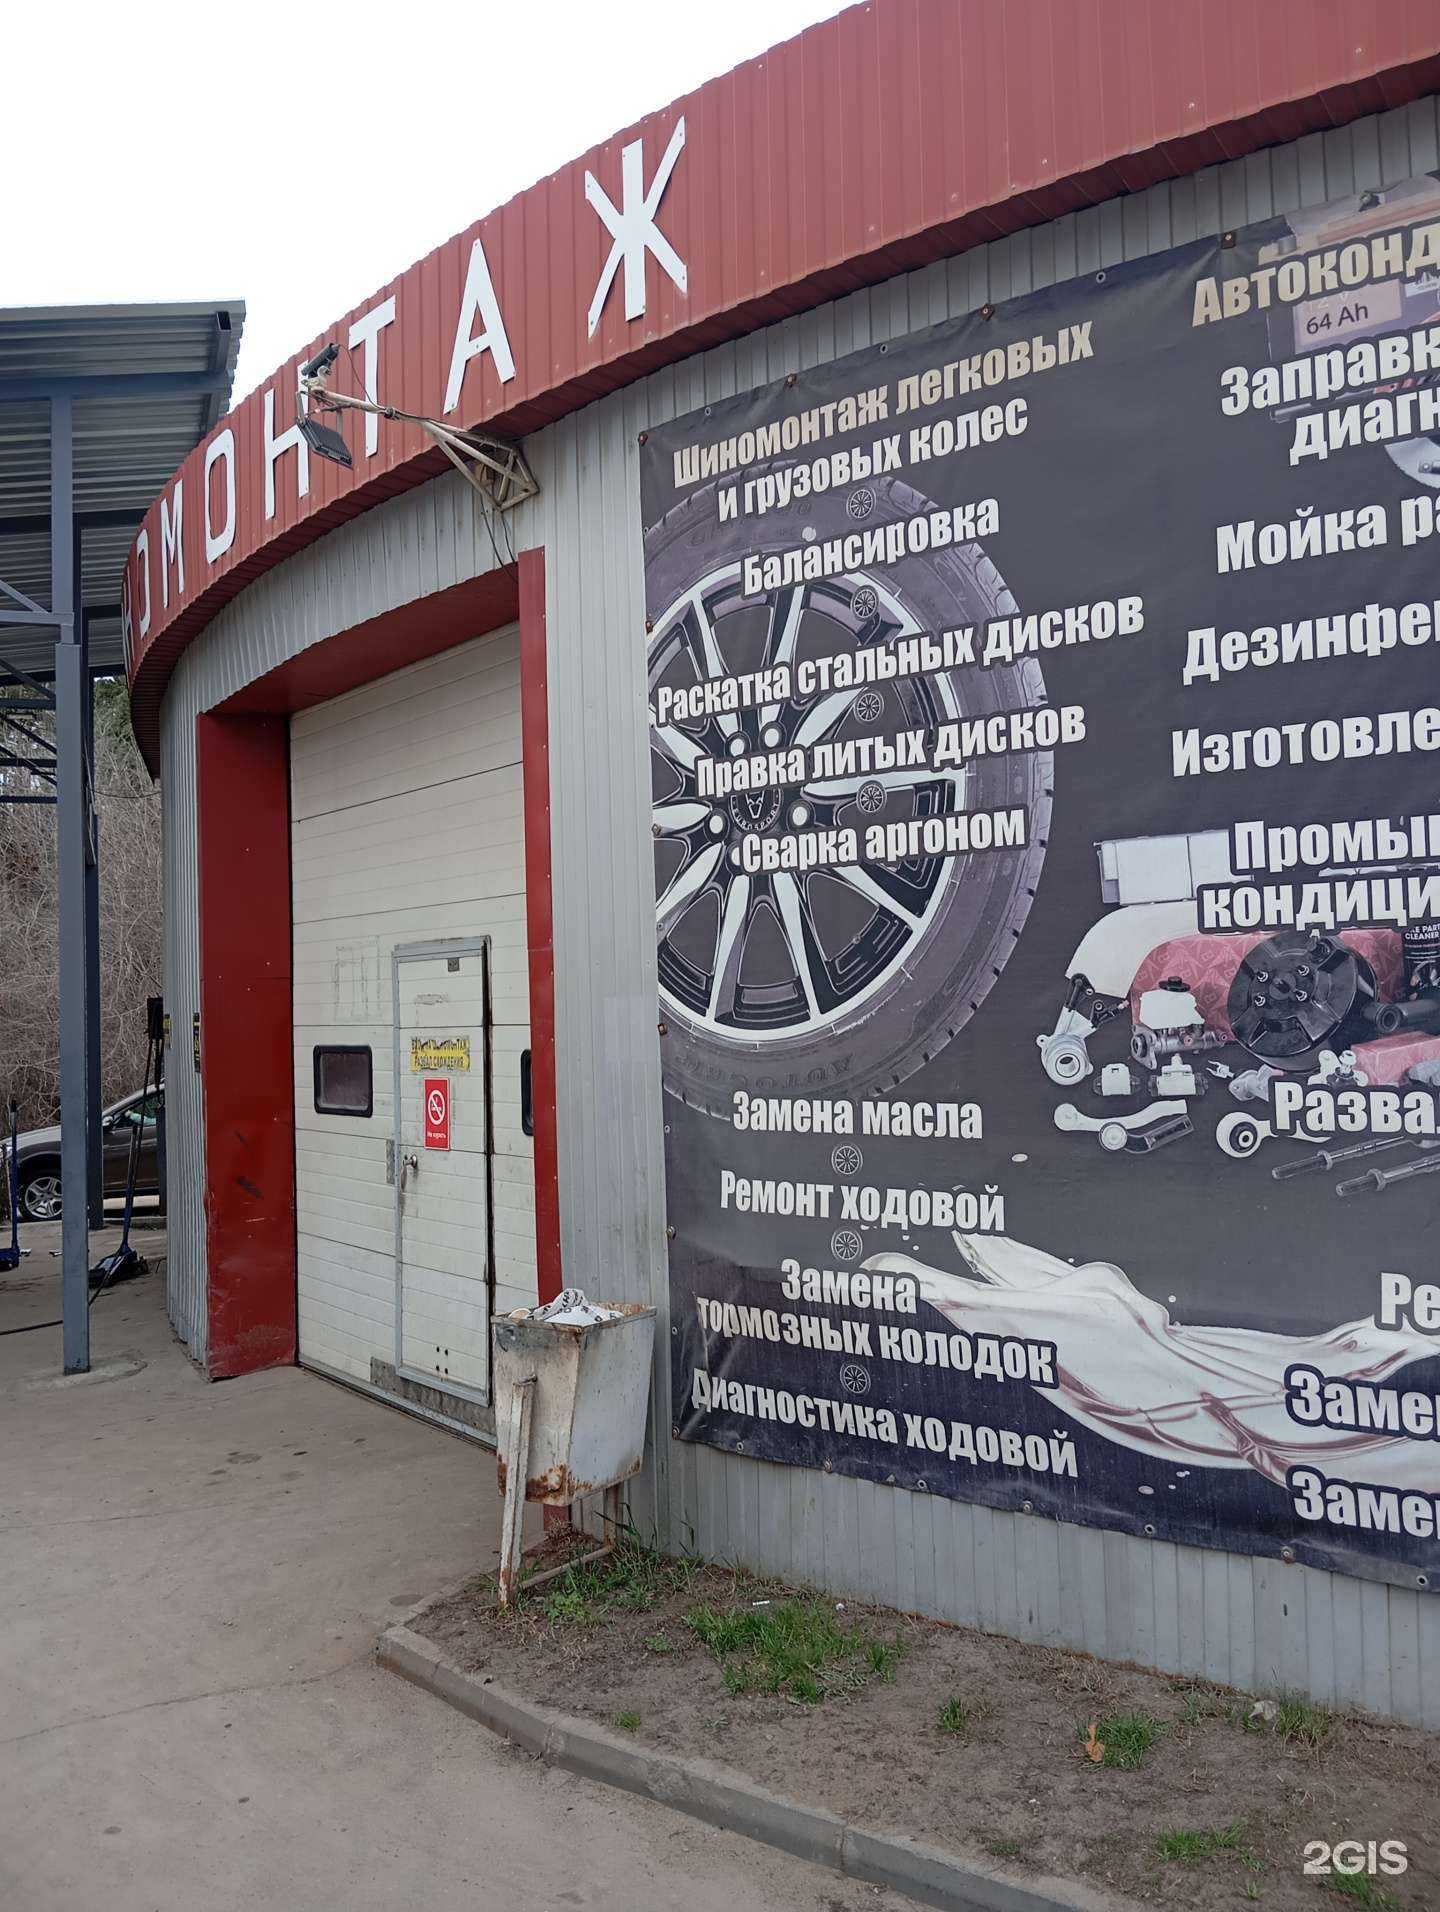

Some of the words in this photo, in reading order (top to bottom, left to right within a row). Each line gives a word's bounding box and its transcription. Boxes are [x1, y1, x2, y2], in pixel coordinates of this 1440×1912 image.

[1192, 223, 1440, 328] Автоконд
[1306, 313, 1332, 334] 64
[1338, 303, 1369, 327] Ah
[121, 116, 688, 676] НОМОНТАЖ
[673, 384, 888, 488] Шиномонтаж
[896, 321, 1095, 415] легковых
[1220, 326, 1440, 416] Заправк
[717, 485, 738, 522] и
[744, 434, 902, 515] грузовых
[909, 398, 1029, 464] колес
[742, 498, 1000, 596] Балансировка
[1216, 505, 1388, 574] Мойка
[1401, 494, 1440, 547] р
[657, 665, 791, 725] Раскатка
[797, 626, 974, 694] стальных
[983, 596, 1145, 666] дисков
[1183, 600, 1440, 686] Дезинфе
[696, 747, 805, 799] Правка
[811, 727, 927, 780] литых
[934, 705, 1087, 768] дисков
[1172, 707, 1440, 777] Изготовле
[742, 827, 858, 873] Сварка
[866, 809, 1025, 865] аргоном
[1202, 875, 1440, 931] кондици
[1404, 931, 1440, 940] CLEANER
[733, 1090, 853, 1135] Замена
[862, 1100, 983, 1139] масла
[1274, 1081, 1440, 1134] Разва
[720, 1170, 834, 1218] Ремонт
[840, 1184, 1005, 1232] ходовой
[780, 1258, 917, 1314] Замена
[1381, 1272, 1440, 1329] Ре
[697, 1297, 874, 1357] тормозных
[879, 1324, 1056, 1384] колодок
[691, 1367, 898, 1445] Диагностика
[903, 1413, 1079, 1478] ходовой
[1290, 1369, 1440, 1436] Заме
[1291, 1470, 1440, 1541] Заме
